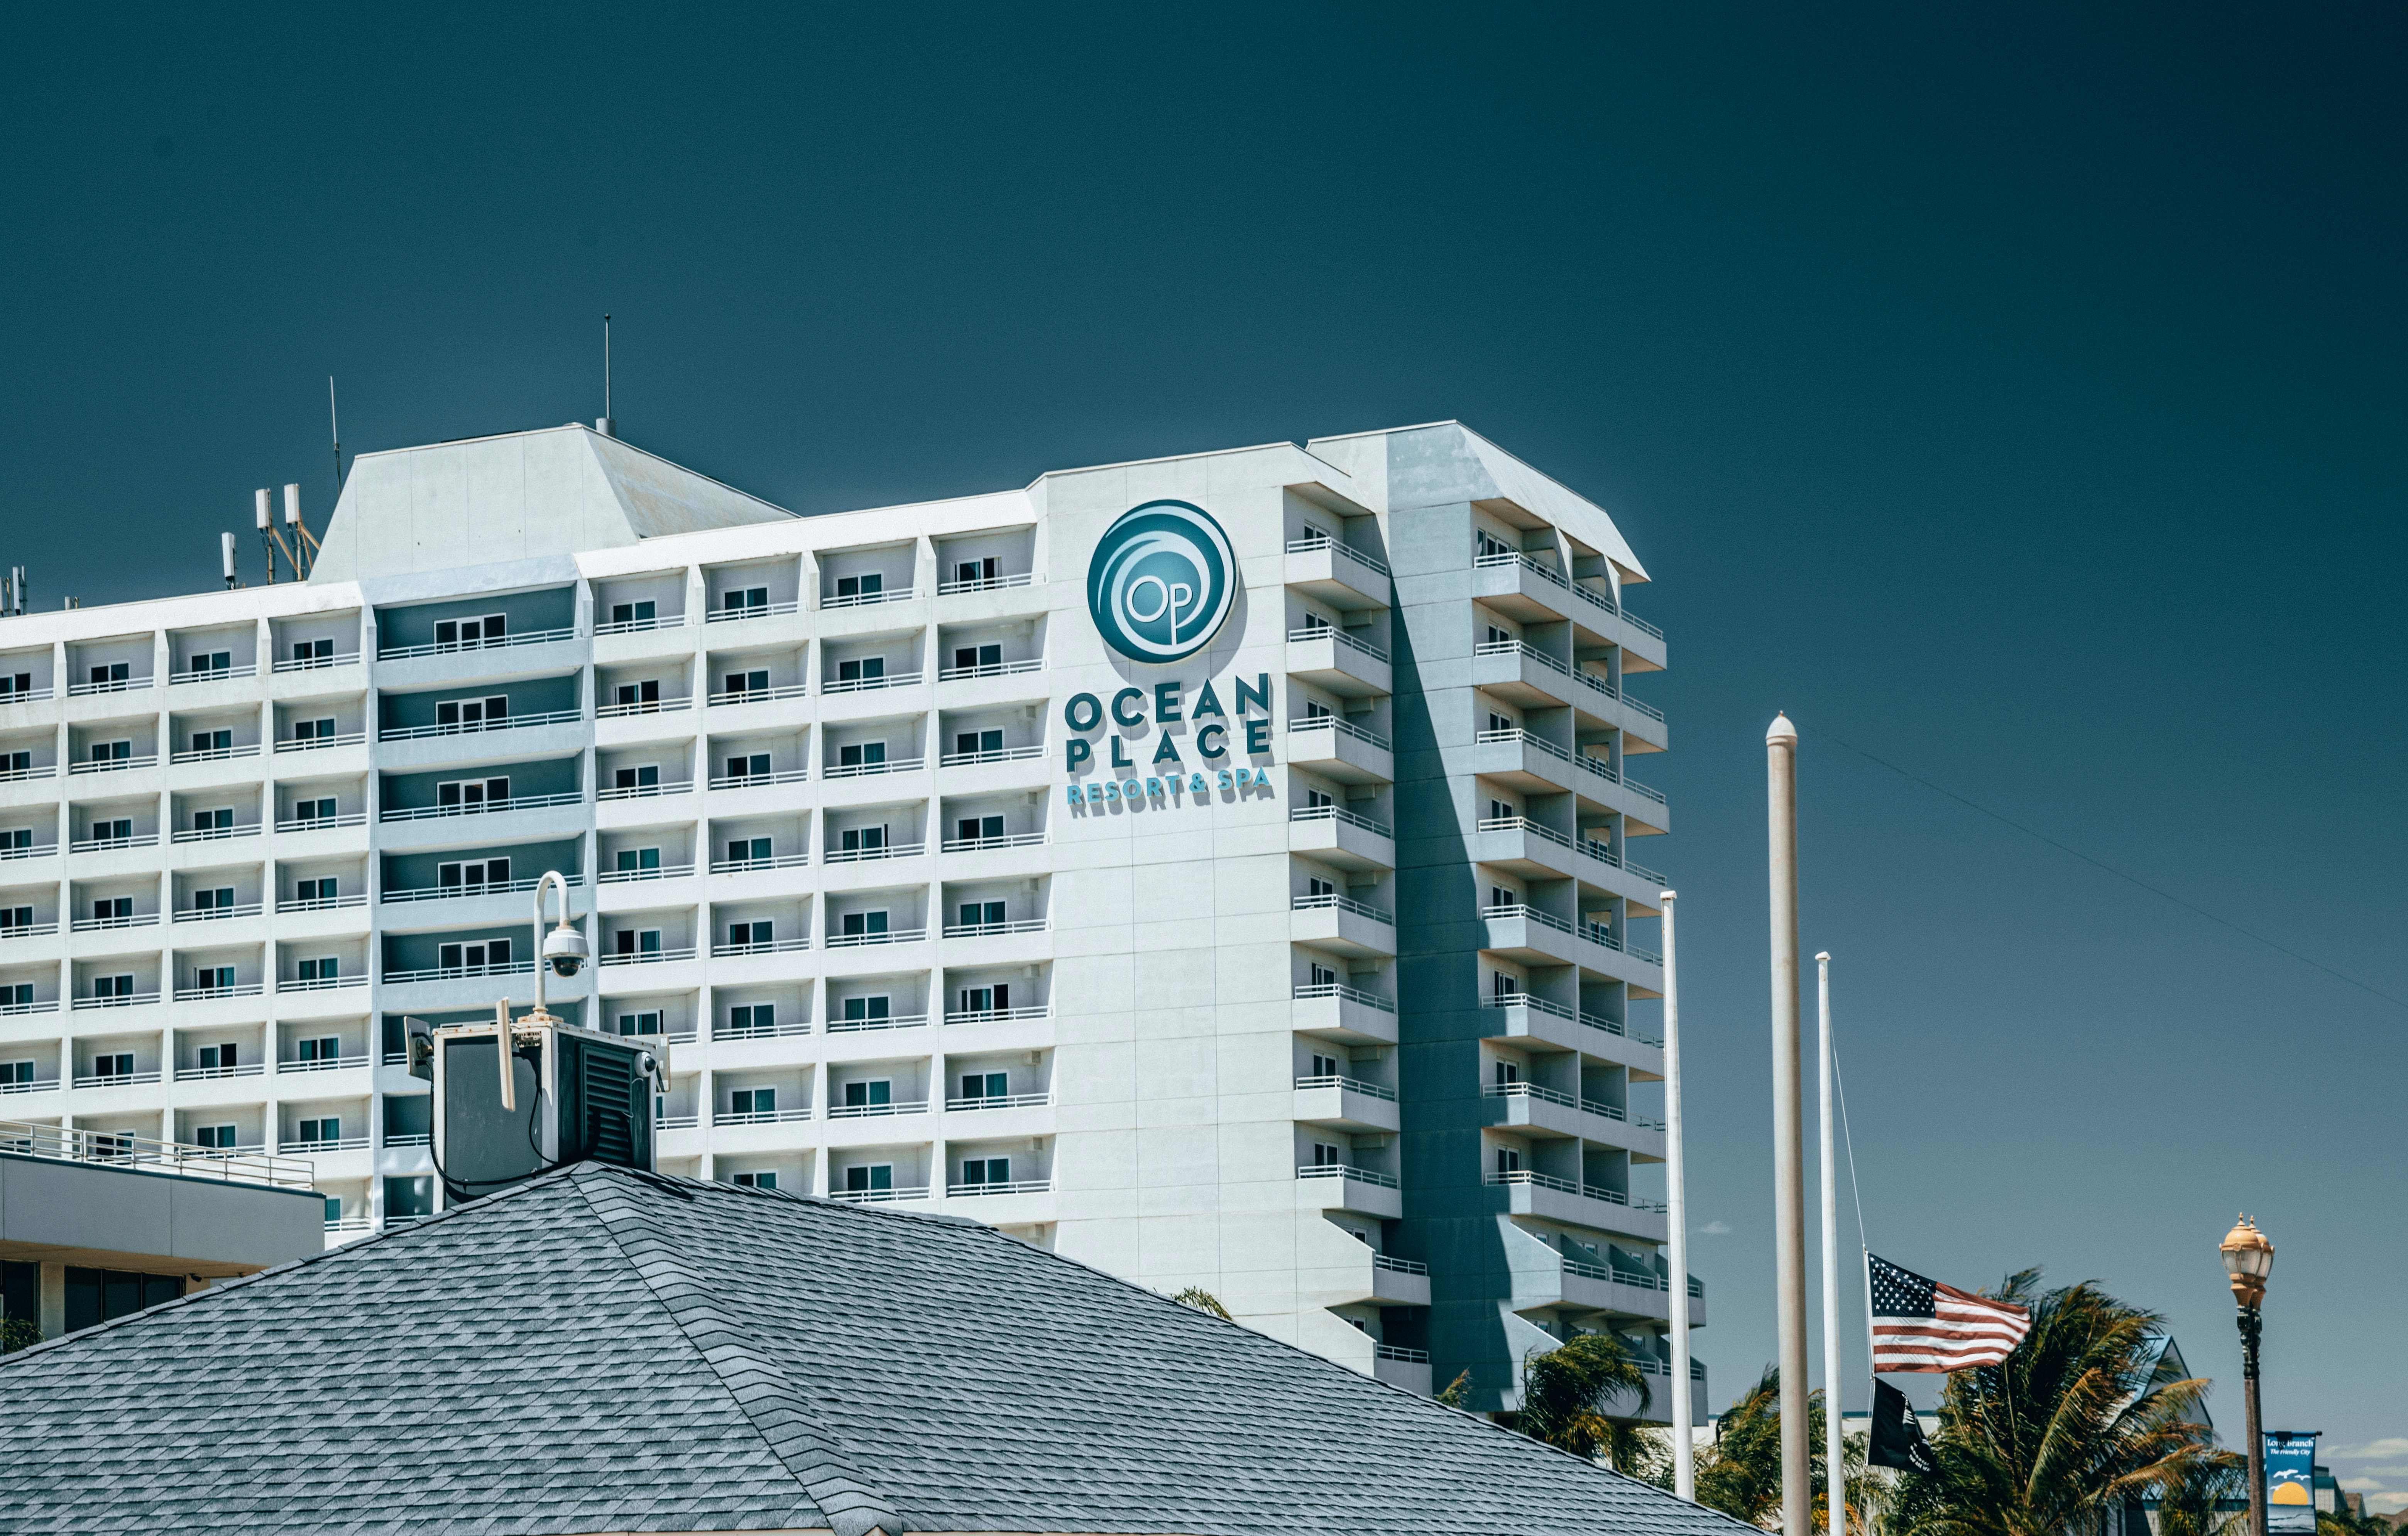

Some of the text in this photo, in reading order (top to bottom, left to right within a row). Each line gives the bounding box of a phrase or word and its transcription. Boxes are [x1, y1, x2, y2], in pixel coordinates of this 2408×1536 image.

[1126, 575, 1193, 645] OP
[1065, 673, 1269, 732] OCEAN
[1066, 719, 1270, 773] PLACE
[1067, 766, 1271, 805] RESORT & SPA
